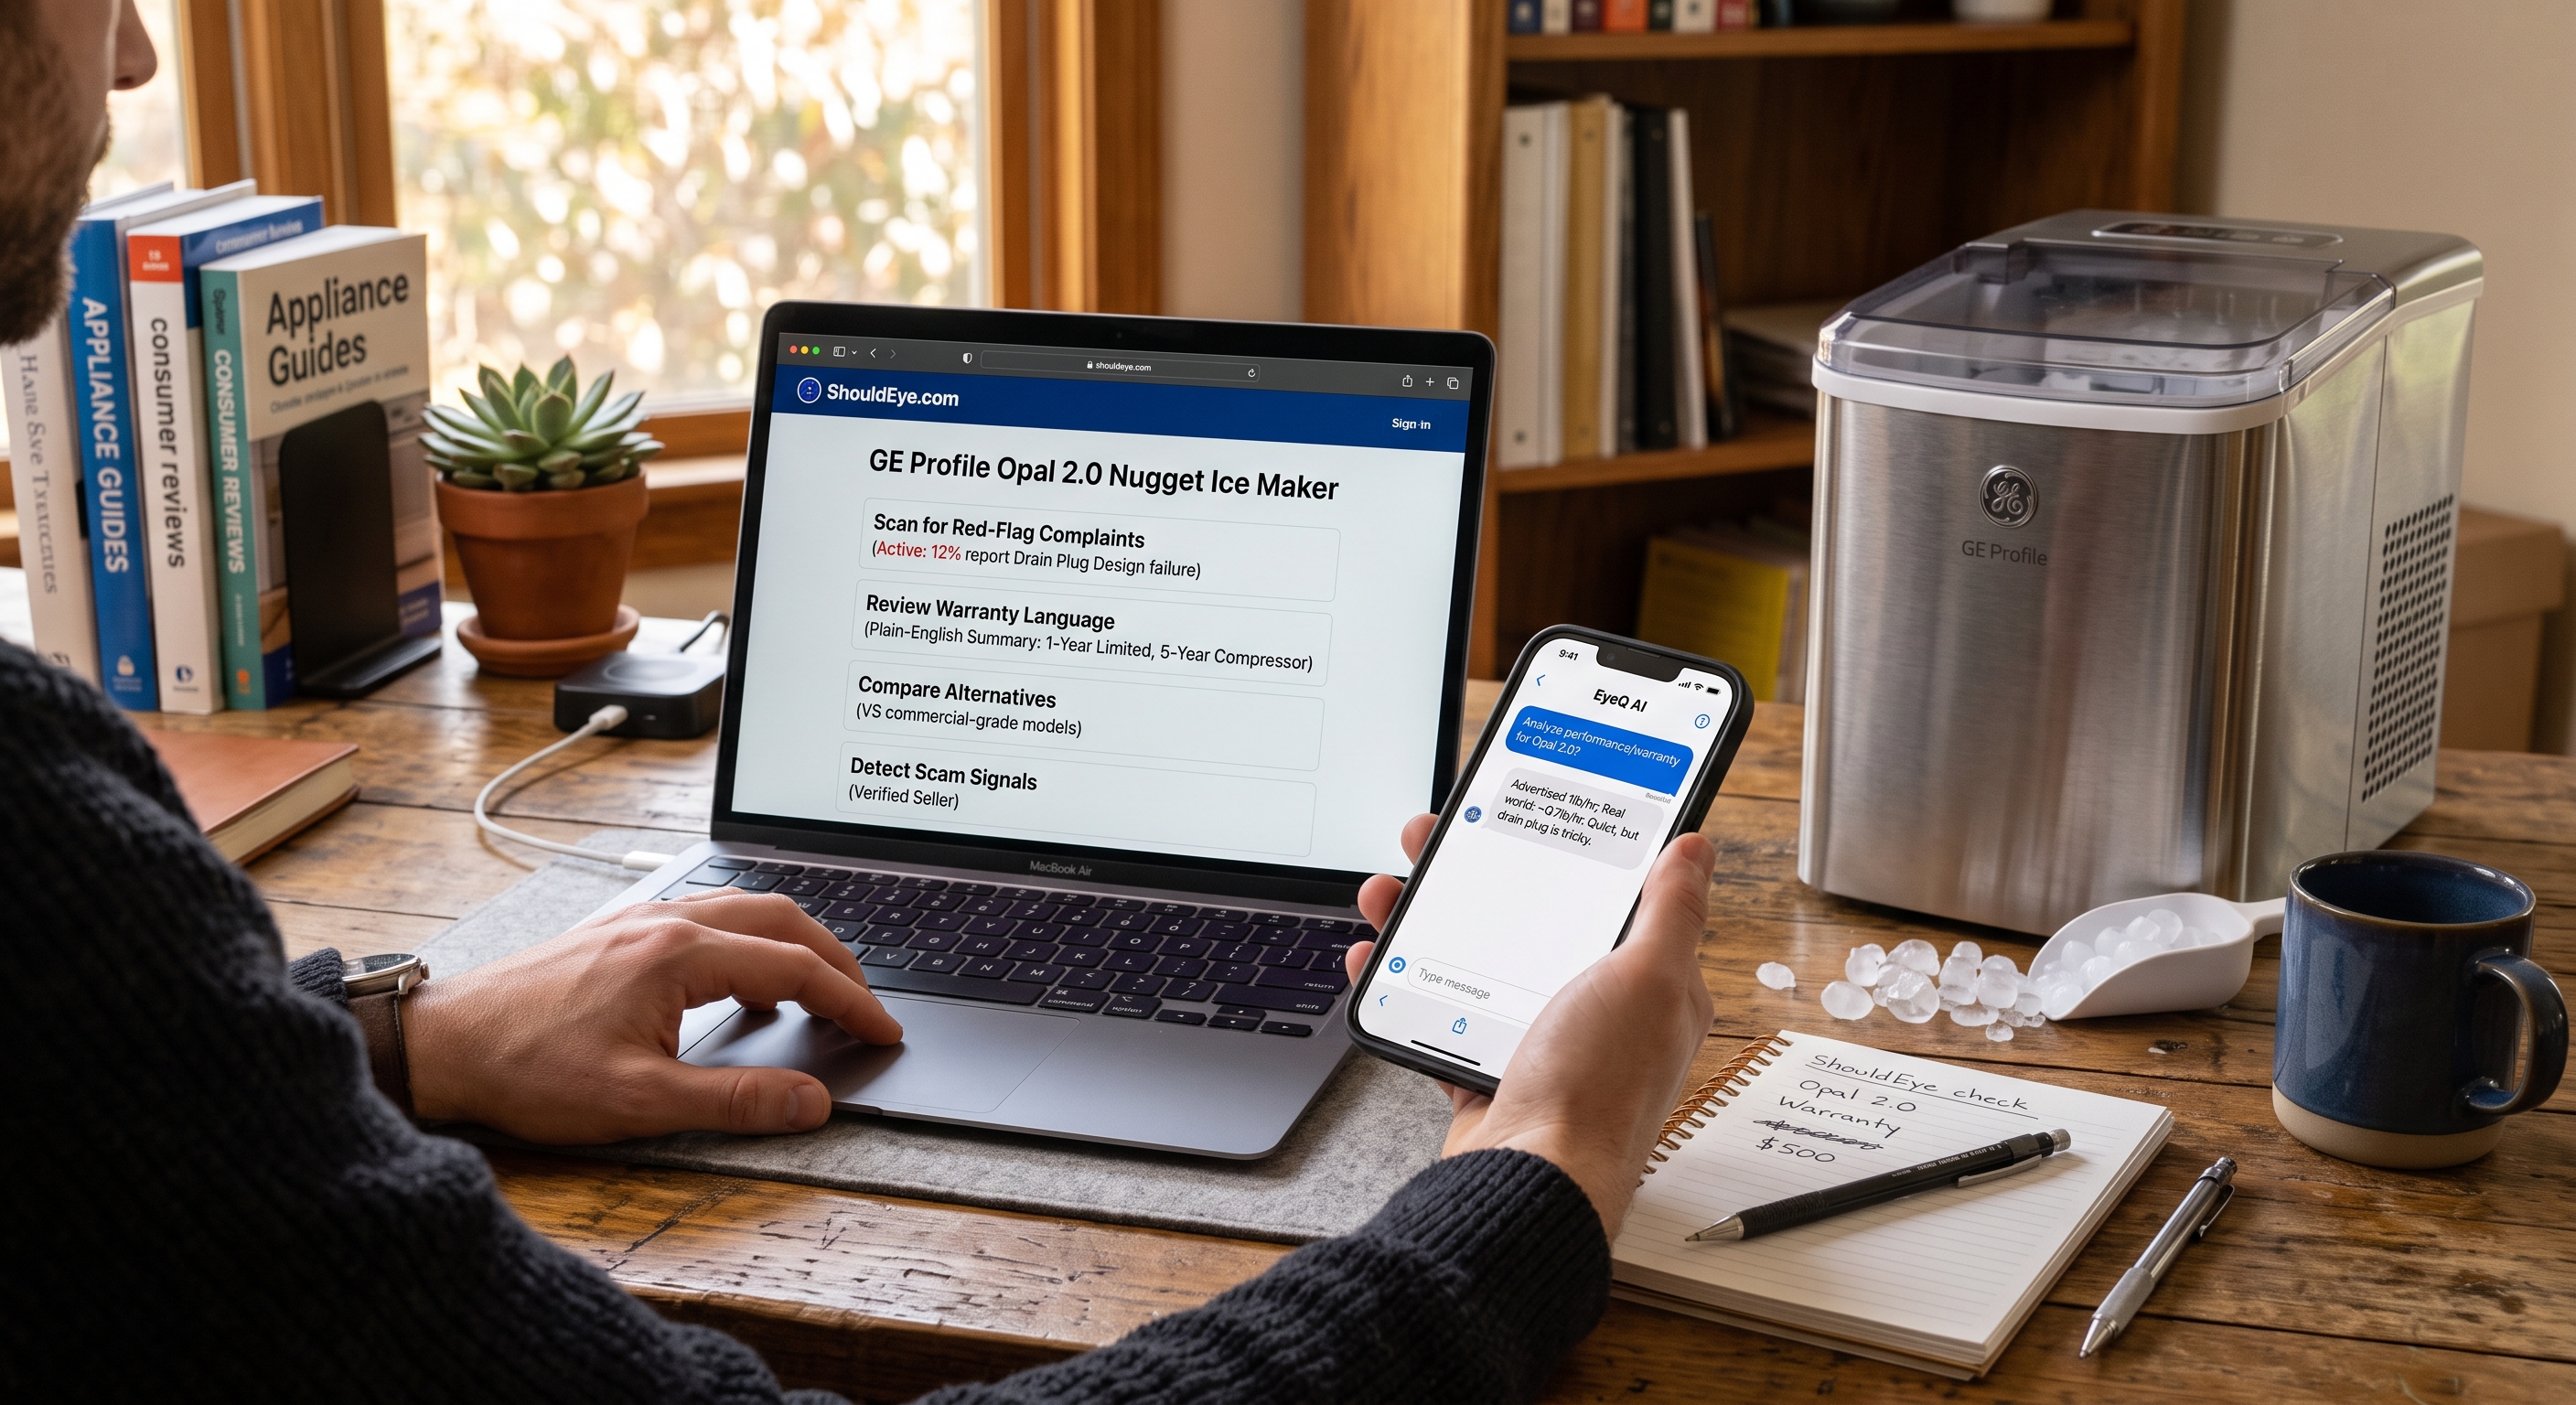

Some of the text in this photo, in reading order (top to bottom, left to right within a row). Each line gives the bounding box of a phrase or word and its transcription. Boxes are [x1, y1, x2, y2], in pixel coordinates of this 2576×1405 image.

[266, 274, 409, 339] Appliance
[269, 329, 367, 386] Guides
[1095, 361, 1152, 372] shouldeye.com
[214, 349, 239, 471] CONSUMER
[827, 383, 960, 407] ShouldEye.com
[82, 297, 129, 573] APPLIANCE GUIDES
[151, 318, 188, 567] consumer reviews
[869, 448, 1339, 500] GE Profile Opal 2.0 Nugget Ice Maker
[223, 476, 245, 574] REVIEWS
[874, 513, 1145, 549] Scan for Red-Flag Complaints
[872, 540, 1201, 580] (Active: 12% report Drain Plug Design failure)
[1962, 540, 2047, 566] GE Profile
[866, 594, 1115, 633] Review Warranty Language
[864, 620, 1313, 673] (Plain-English Summary: 1-Year Limited, 5-Year Compressor)
[1559, 649, 1579, 661] 9:41
[858, 675, 1057, 708] Compare Alternatives
[1593, 689, 1648, 713] EyeQ AI
[856, 702, 1082, 738] (VS commercial-grade models)
[1522, 716, 1563, 735] Analyze
[1516, 731, 1581, 756] for Opal 2.0?
[851, 756, 1037, 791] Detect Scam Signals
[849, 783, 959, 811] (Verified Seller)
[1510, 778, 1568, 802] Advertised
[1601, 803, 1626, 819] Real
[1497, 810, 1523, 826] drain
[1524, 819, 1548, 836] plug
[1550, 823, 1561, 836] is
[1505, 795, 1537, 811] world:
[1620, 826, 1639, 841] but
[1030, 860, 1092, 876] MacBook Air
[1419, 967, 1491, 1000] Type message
[1799, 1079, 1916, 1112] Opal 2.0
[1953, 1088, 2028, 1110] check
[1779, 1096, 1901, 1139] Warranty
